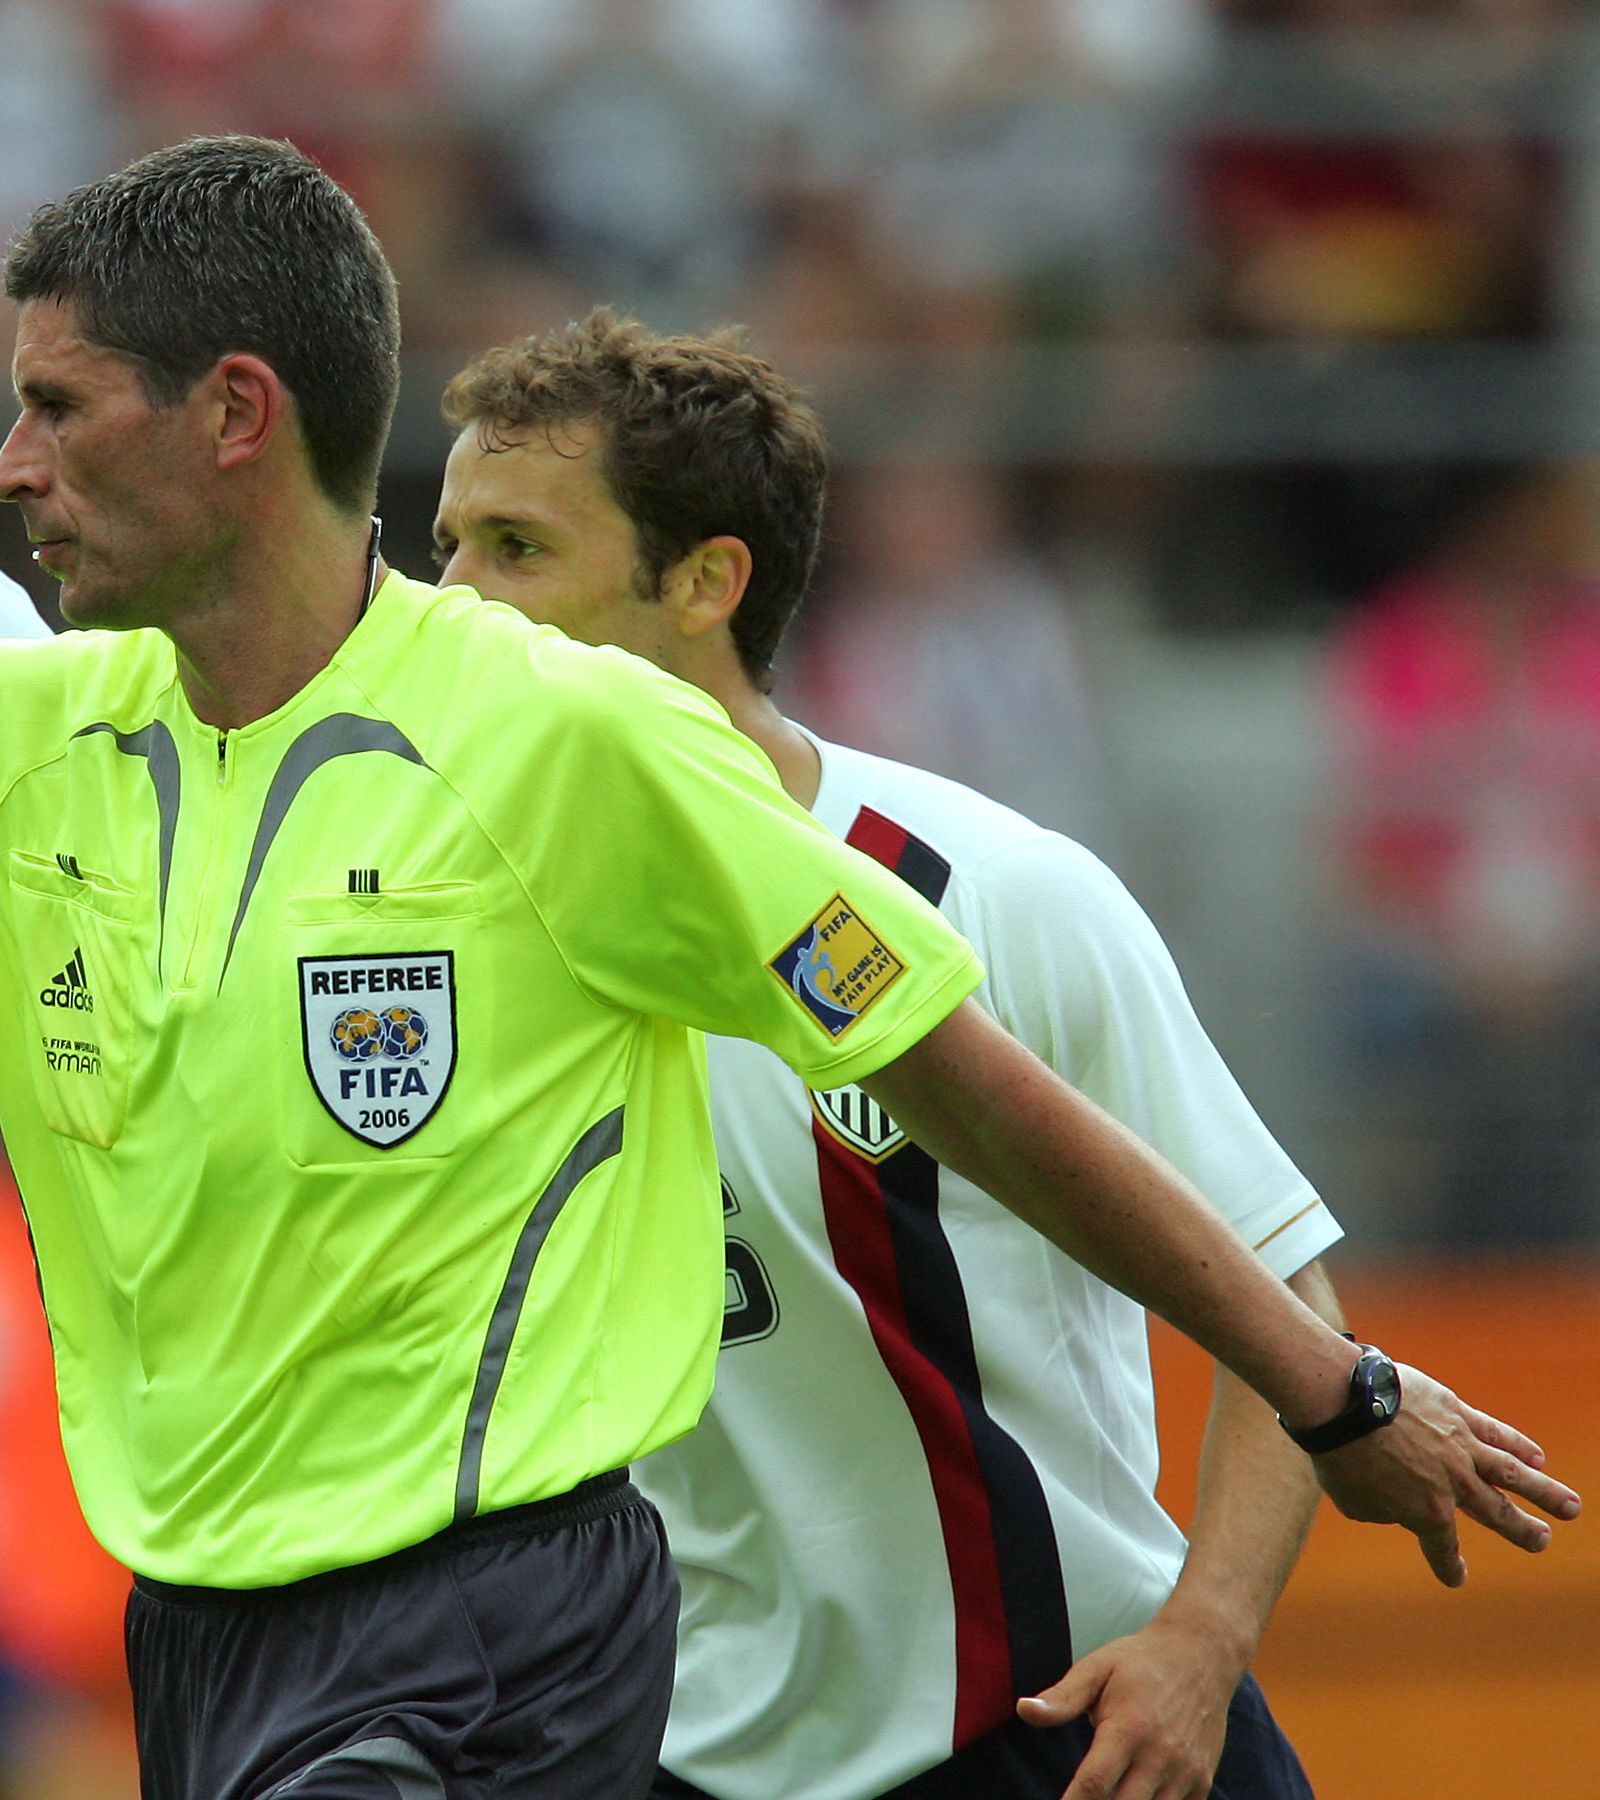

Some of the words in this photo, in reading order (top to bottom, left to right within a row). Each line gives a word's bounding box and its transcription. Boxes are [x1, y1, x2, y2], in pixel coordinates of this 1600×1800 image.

[819, 909, 853, 942] FIFA
[311, 966, 443, 995] REFEREE
[832, 979, 848, 997] MY
[847, 954, 873, 982] GAME
[871, 945, 882, 958] IS
[841, 982, 866, 1007] FAIR
[864, 955, 890, 984] PLAY
[50, 1038, 72, 1050] FIFA
[340, 1067, 429, 1099] FIFA
[359, 1108, 410, 1129] 2006
